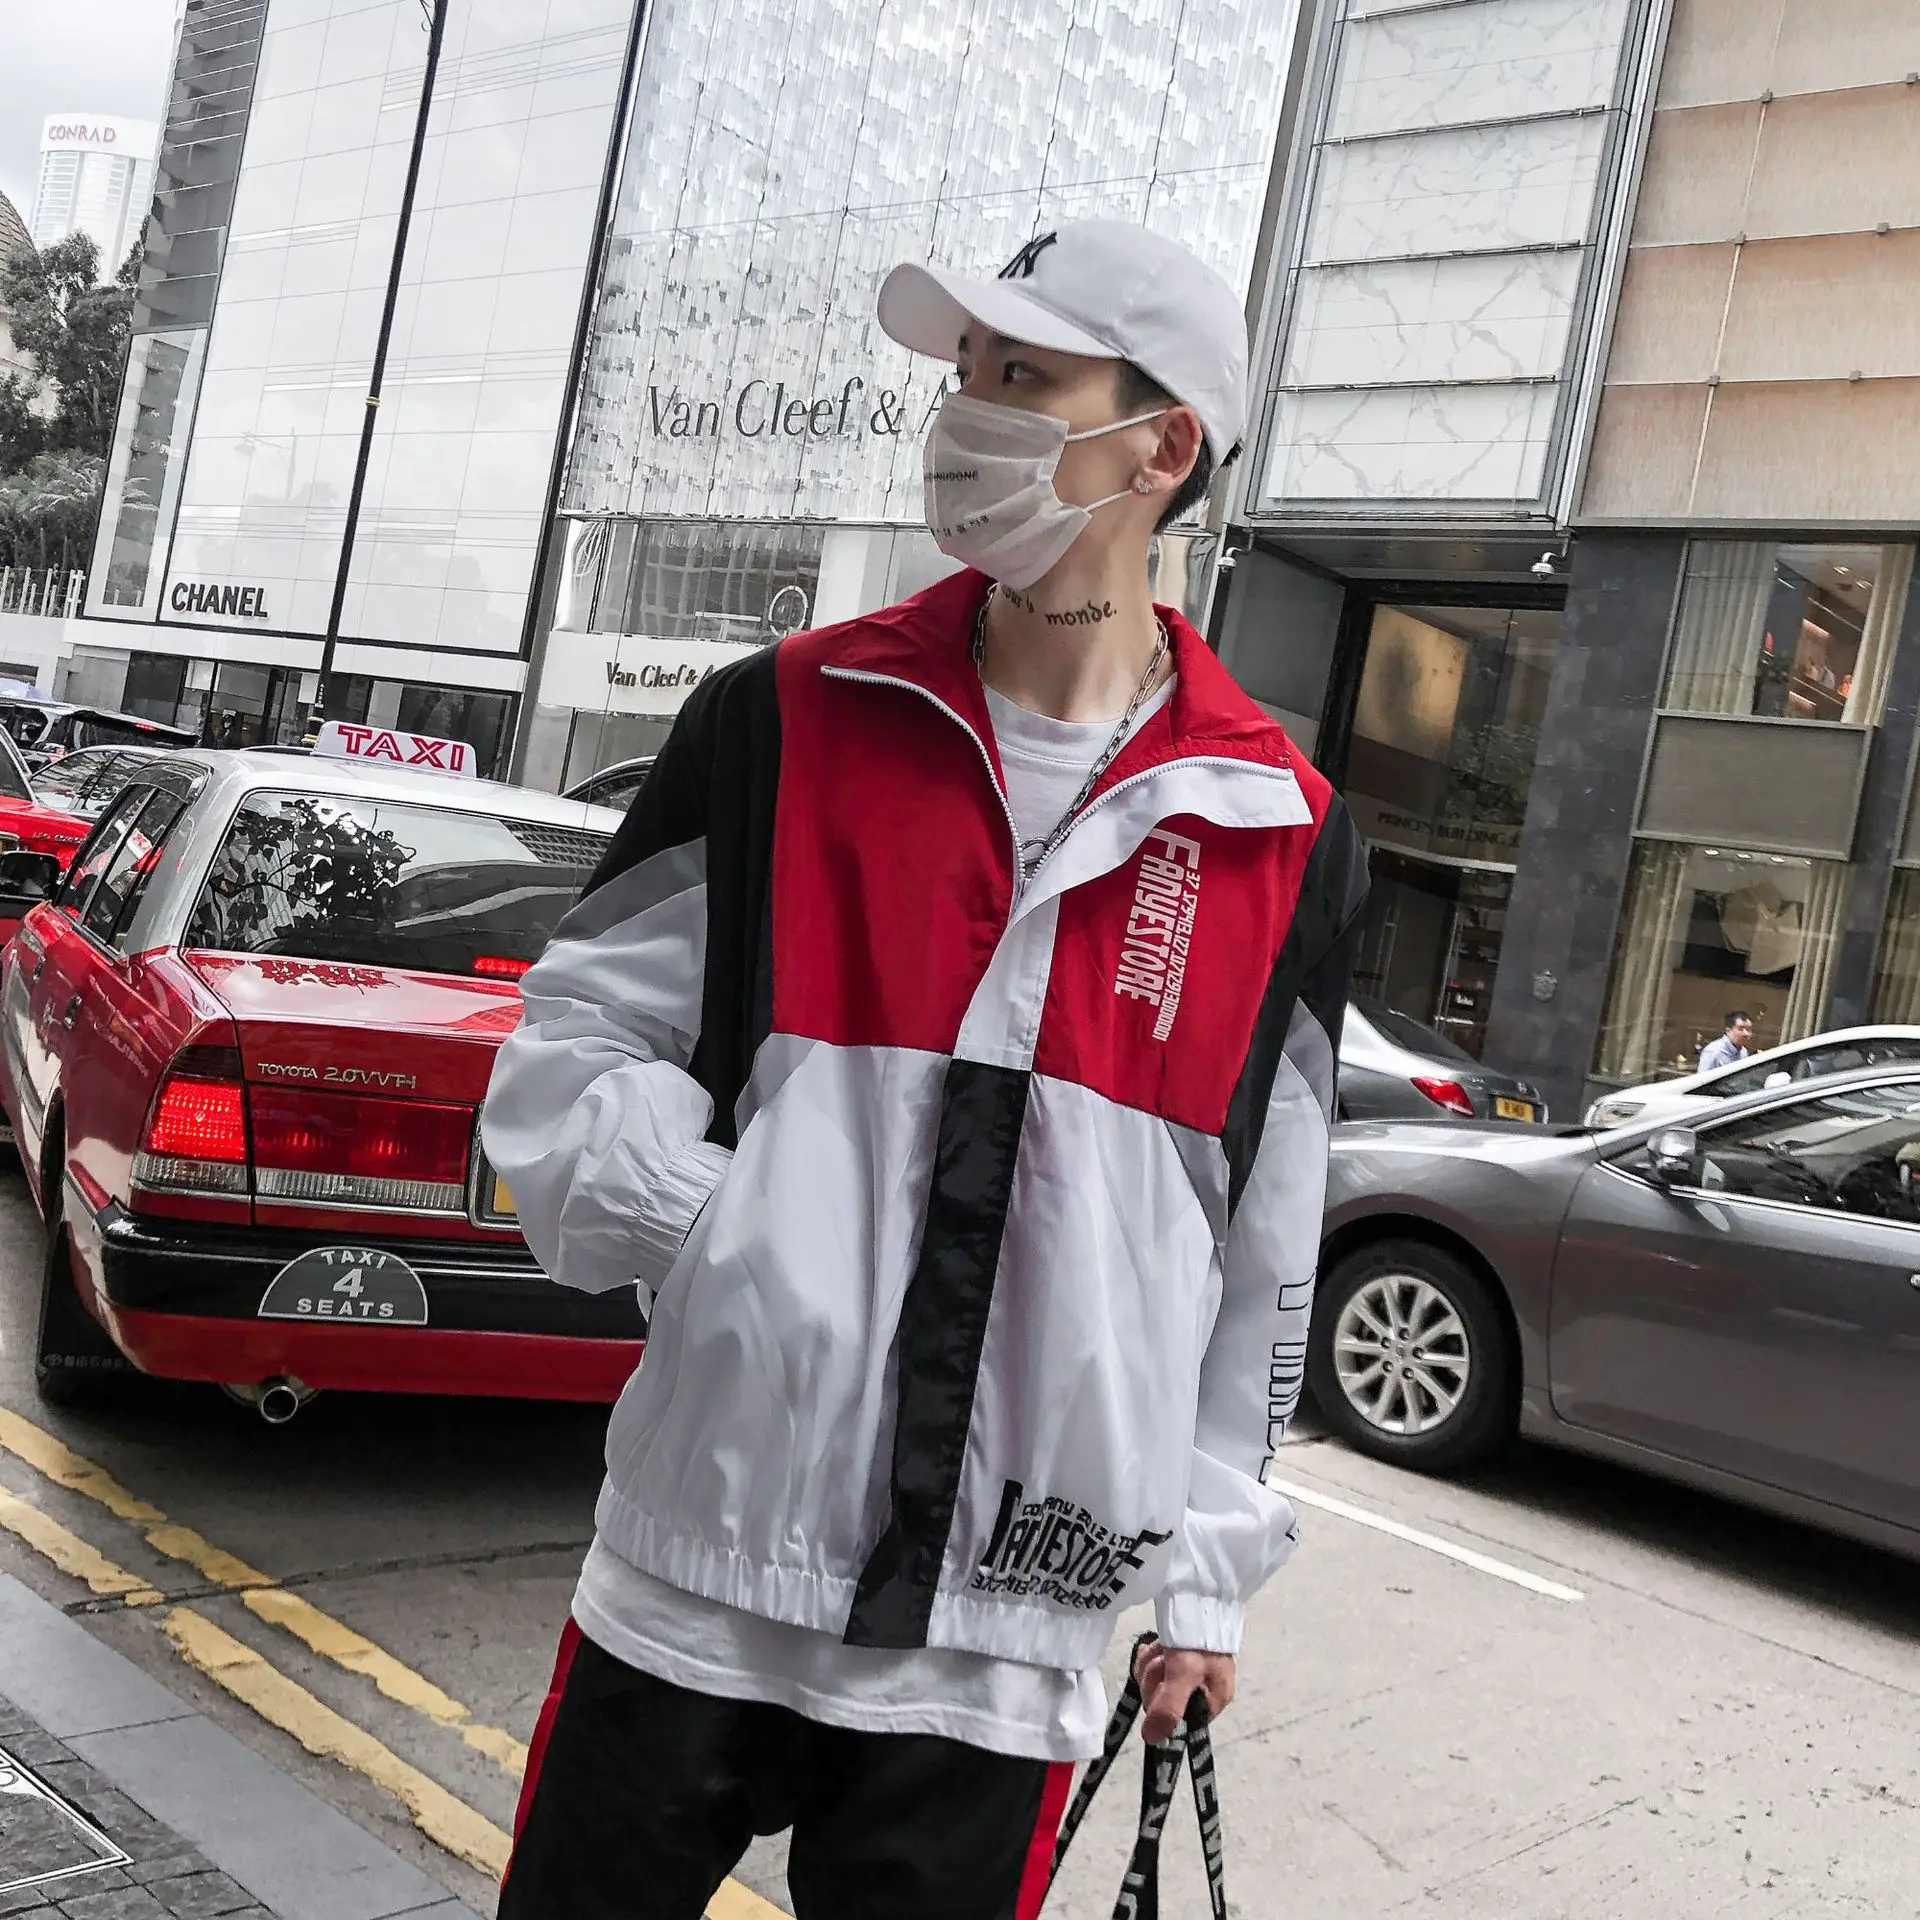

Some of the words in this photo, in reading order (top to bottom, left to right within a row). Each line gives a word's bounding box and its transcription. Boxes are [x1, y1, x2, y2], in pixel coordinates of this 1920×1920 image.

[48, 124, 117, 143] CONRAD
[649, 385, 720, 438] Van
[735, 375, 864, 437] Cleef
[870, 389, 906, 436] &
[171, 582, 268, 618] CHANEL
[606, 661, 637, 687] Van
[640, 664, 687, 688] Cleef
[684, 669, 698, 686] &
[337, 724, 465, 772] TAXI
[257, 1062, 318, 1079] TOYOTA
[320, 1250, 387, 1269] TAXI
[332, 1268, 365, 1298] 4
[296, 1297, 394, 1318] SEATS
